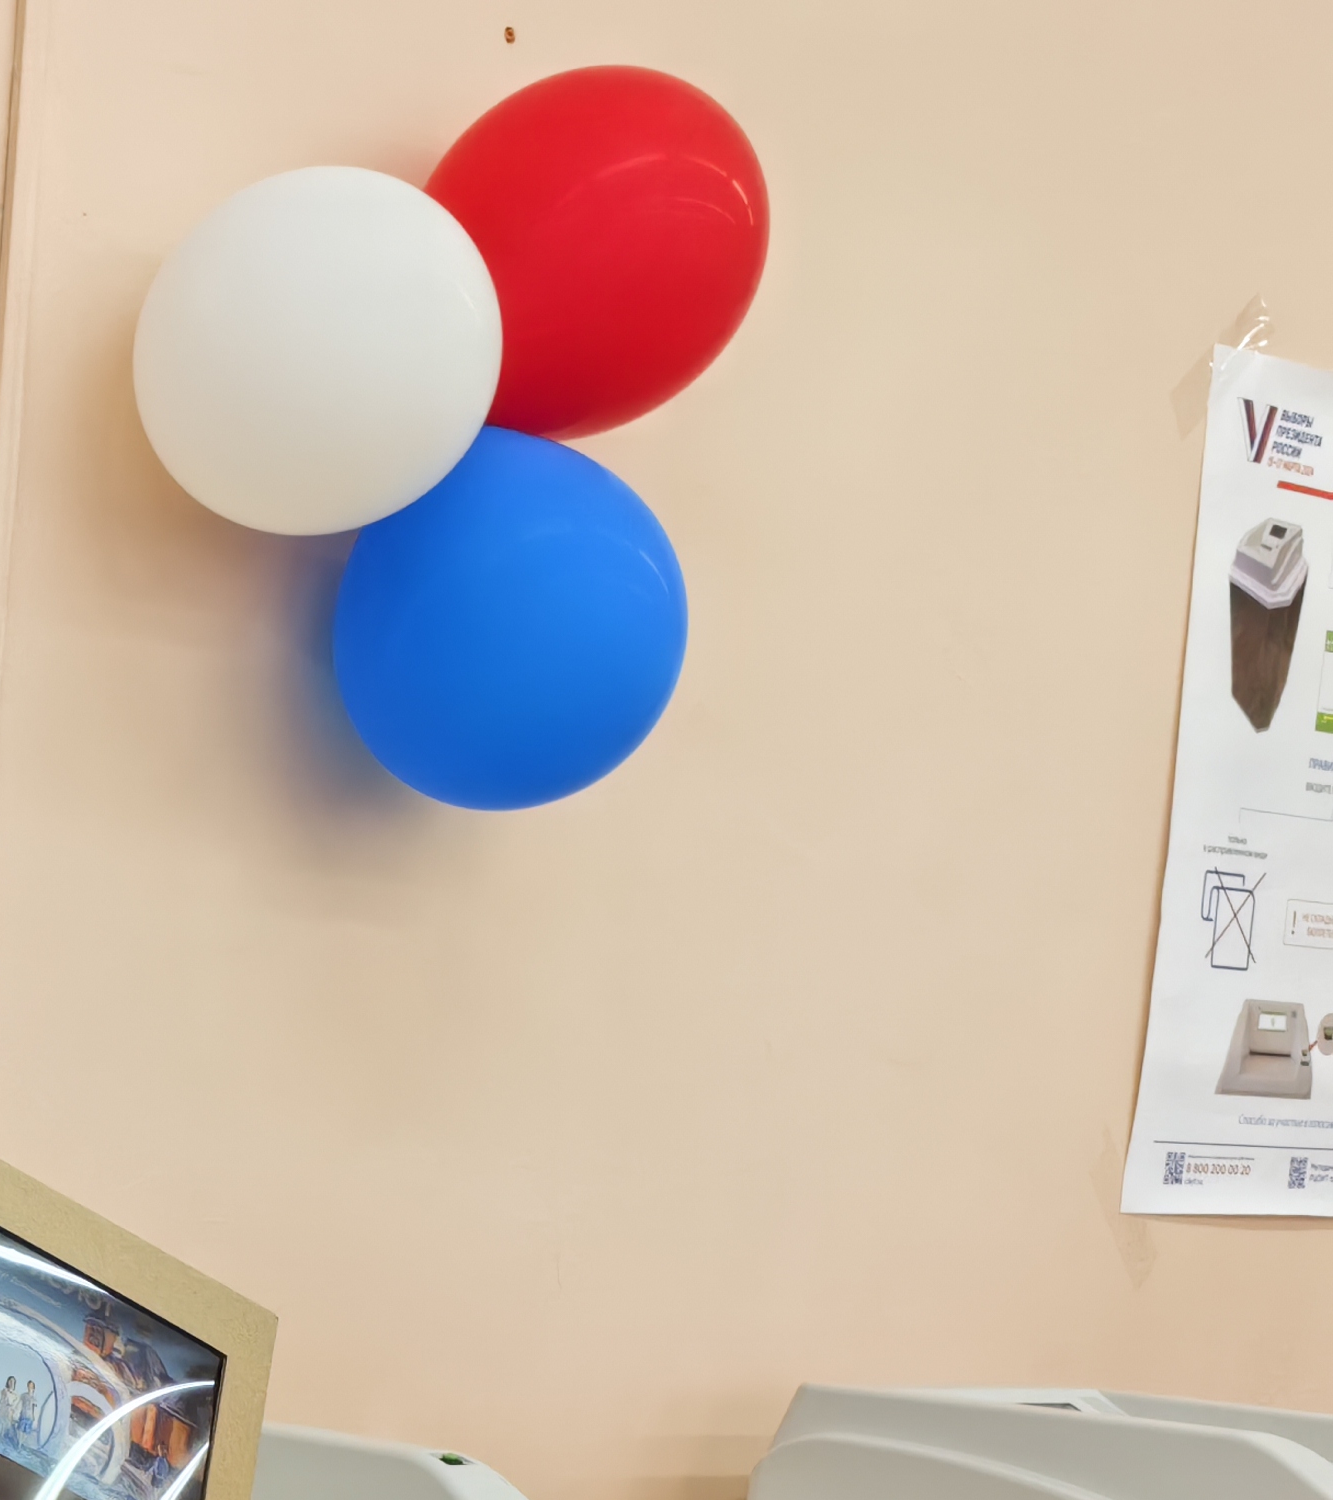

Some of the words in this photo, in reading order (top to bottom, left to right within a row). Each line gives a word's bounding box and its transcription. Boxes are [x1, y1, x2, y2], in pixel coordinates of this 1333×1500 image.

[1276, 425, 1323, 448] ПРЕЗИДЕНТА
[1272, 440, 1302, 459] РОССИИ
[1192, 1162, 1209, 1175] 800
[1210, 1163, 1227, 1176] 200
